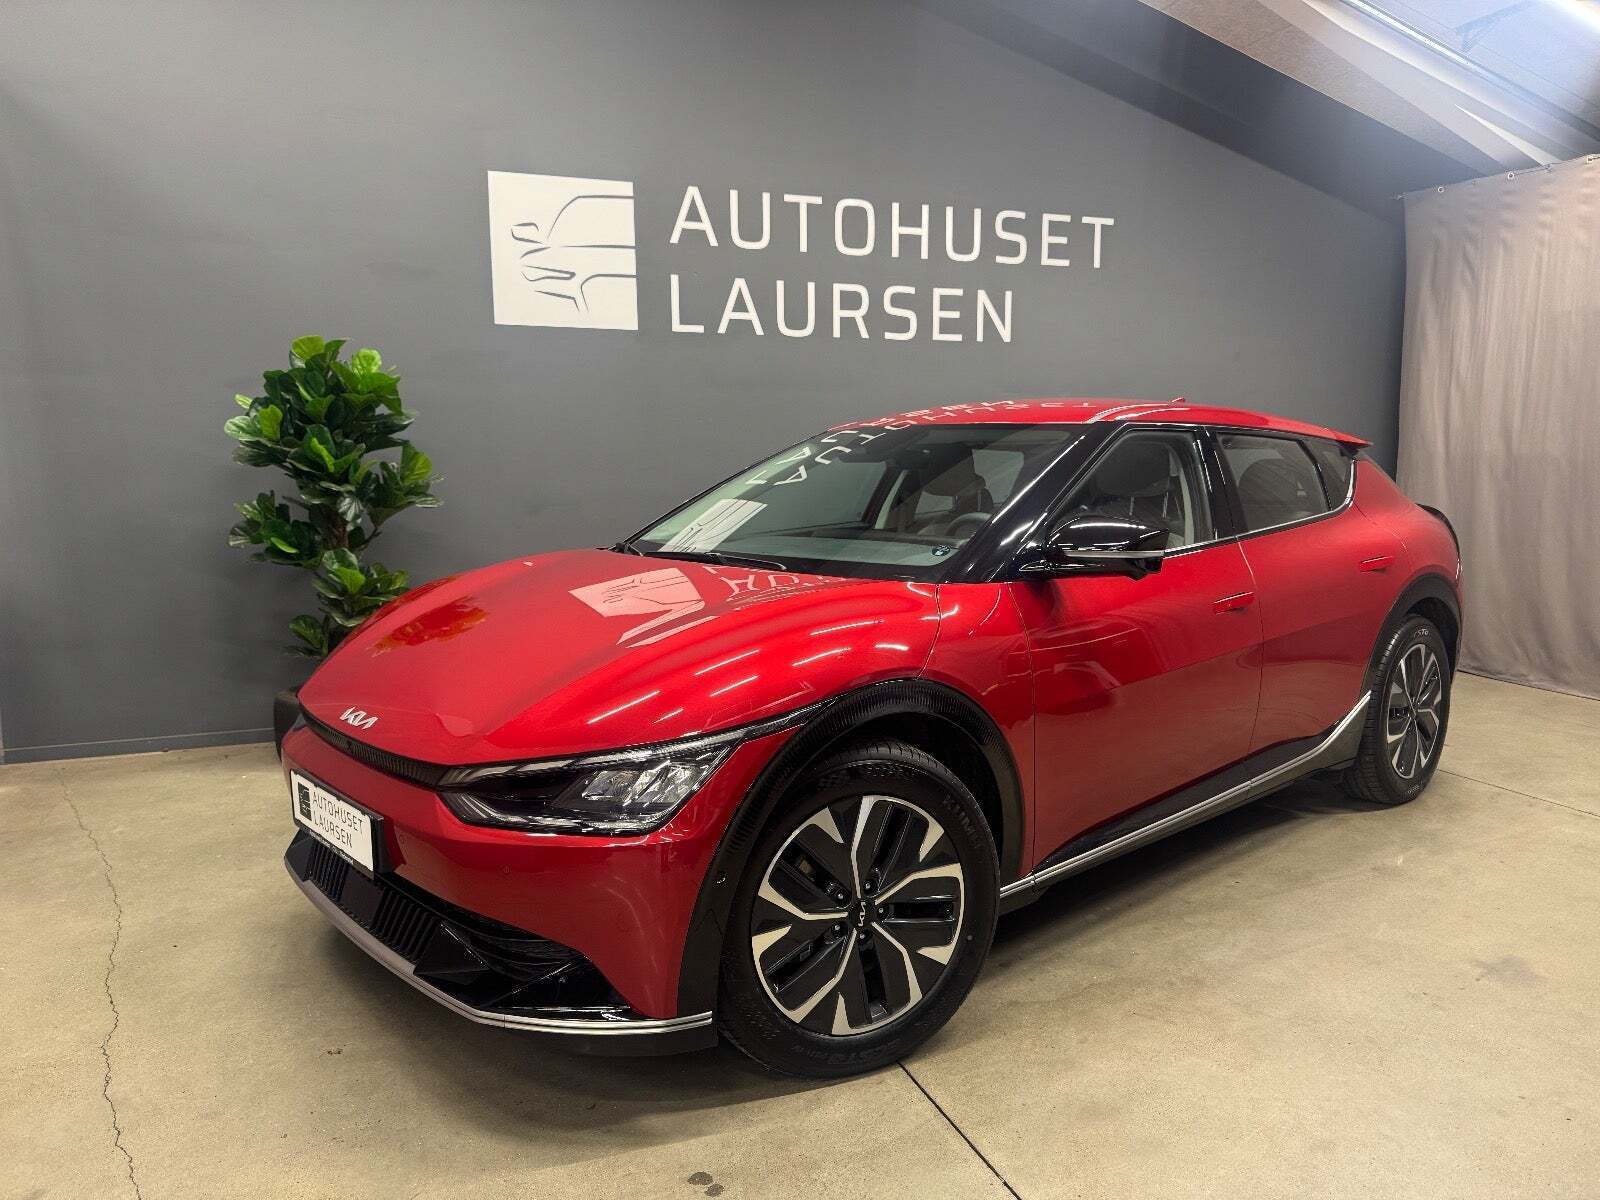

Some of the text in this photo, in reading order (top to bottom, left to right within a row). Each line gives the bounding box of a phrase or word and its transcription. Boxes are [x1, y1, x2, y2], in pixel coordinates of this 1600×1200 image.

[670, 186, 1115, 269] AUTOHUSET
[670, 274, 1013, 343] LAURSEN
[340, 706, 378, 729] KIA
[313, 792, 363, 835] AUTOHUSET
[313, 812, 353, 848] LAURSEN
